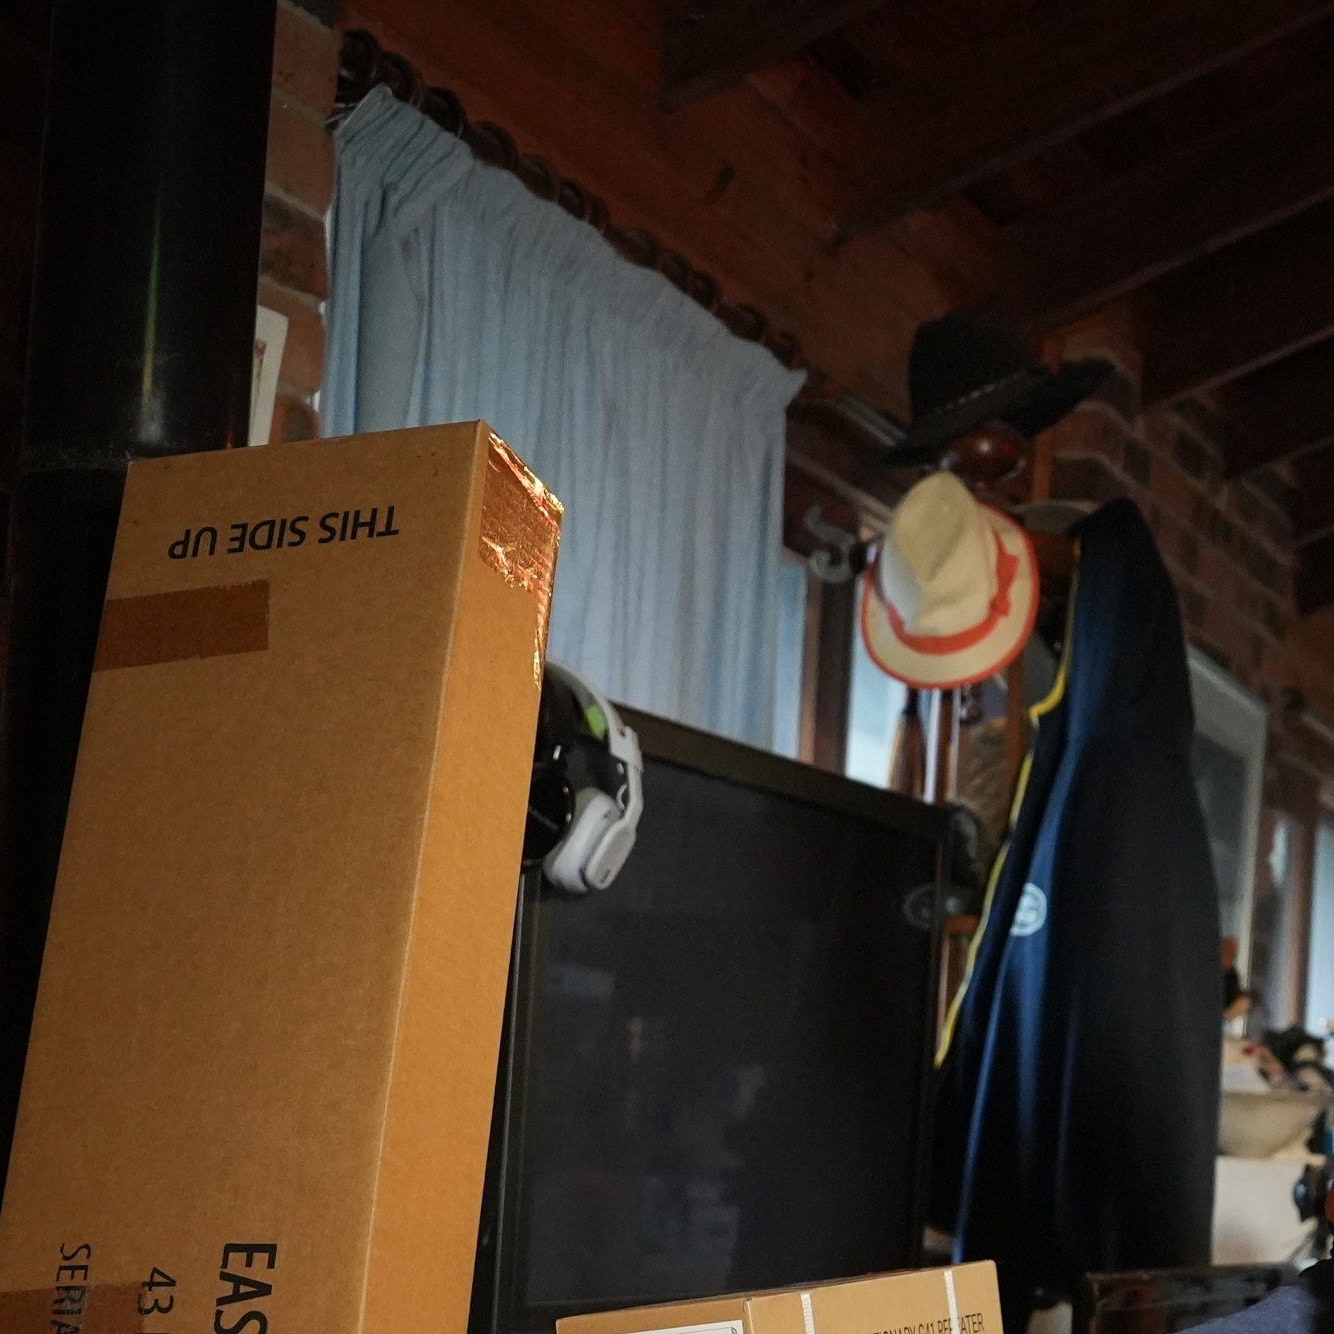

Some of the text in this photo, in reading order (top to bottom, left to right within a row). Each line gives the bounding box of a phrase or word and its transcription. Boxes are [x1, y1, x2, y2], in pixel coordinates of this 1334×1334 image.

[168, 505, 400, 560] THIS SIDE UP
[139, 1265, 178, 1316] 43
